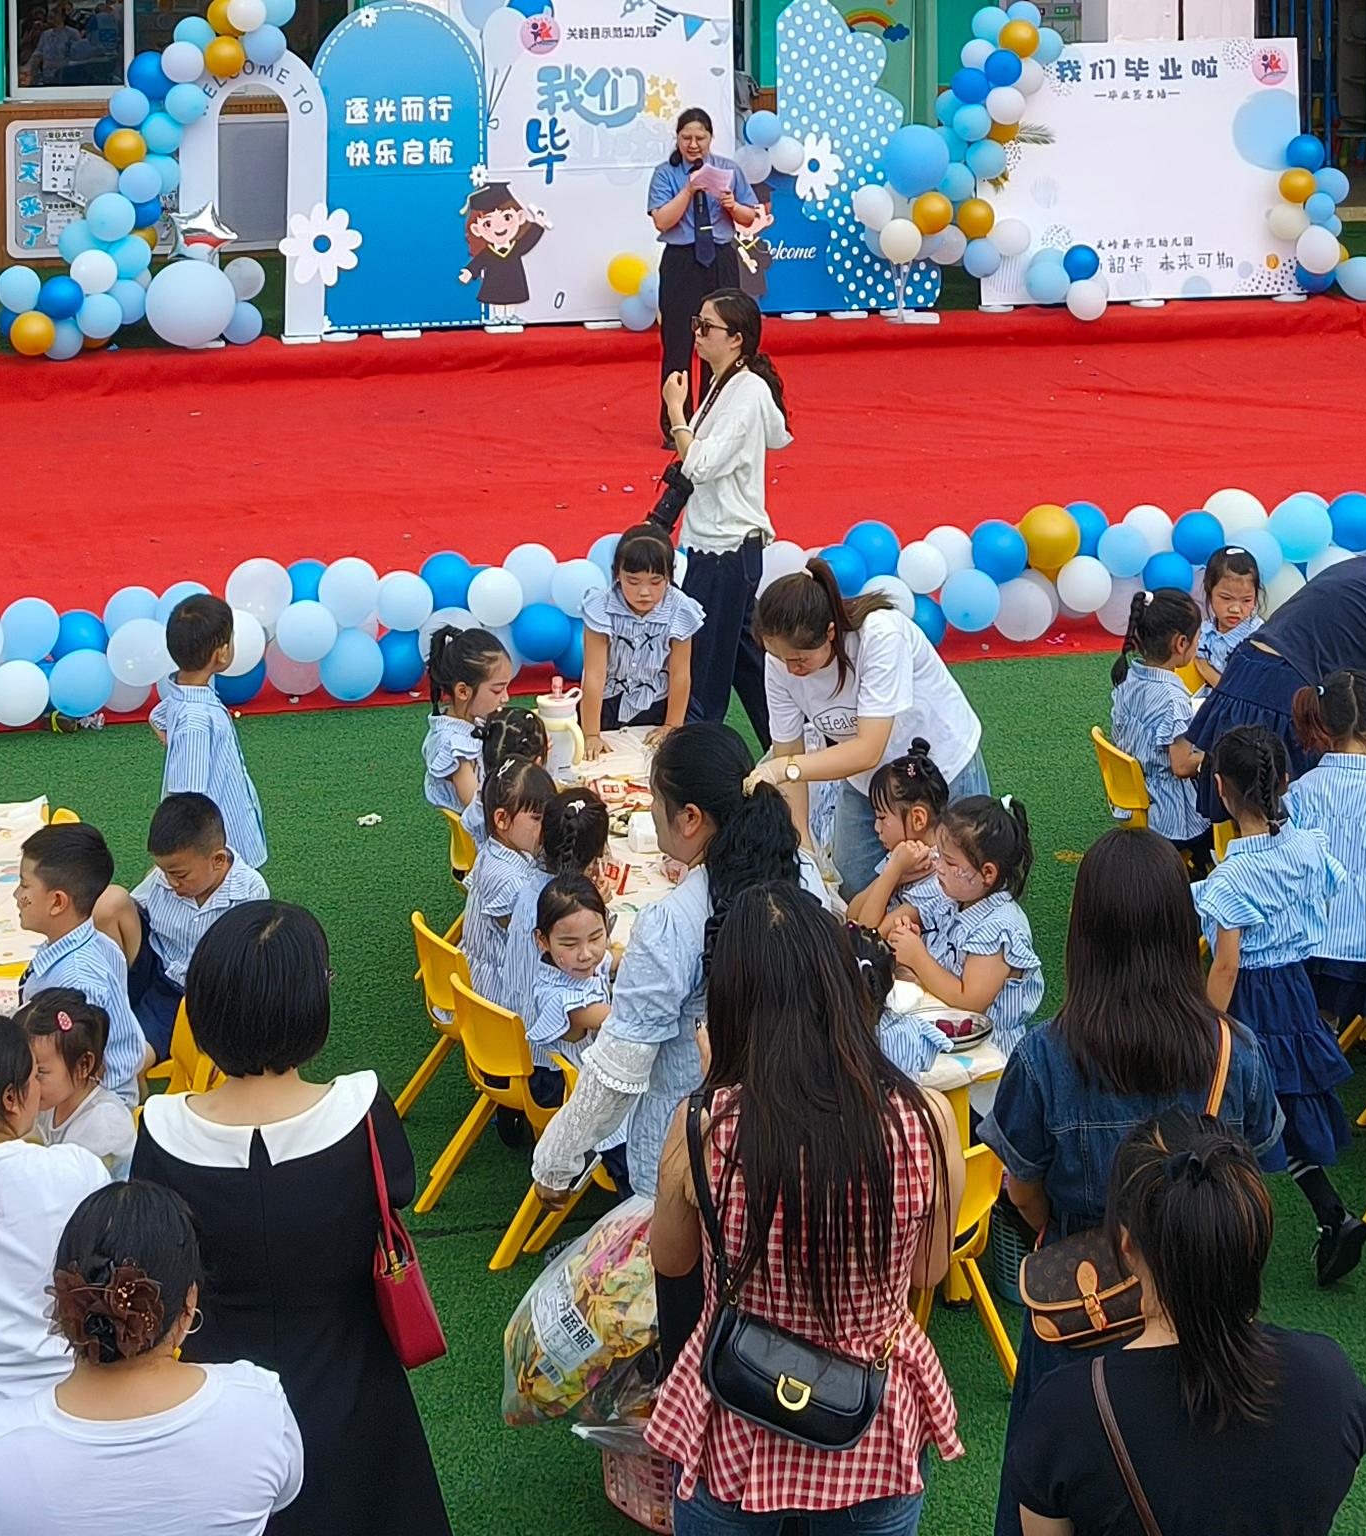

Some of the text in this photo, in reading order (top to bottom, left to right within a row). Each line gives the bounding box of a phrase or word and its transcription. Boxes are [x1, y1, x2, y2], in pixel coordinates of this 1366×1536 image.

[566, 26, 657, 41] 关岭县示范幼儿园
[1055, 56, 1218, 82] 我们毕业啦
[292, 84, 314, 114] TO
[536, 63, 646, 128] 我们
[344, 95, 453, 125] 逐光而行
[345, 139, 455, 166] 快乐启航
[1099, 251, 1235, 274] 韶华 未来可期
